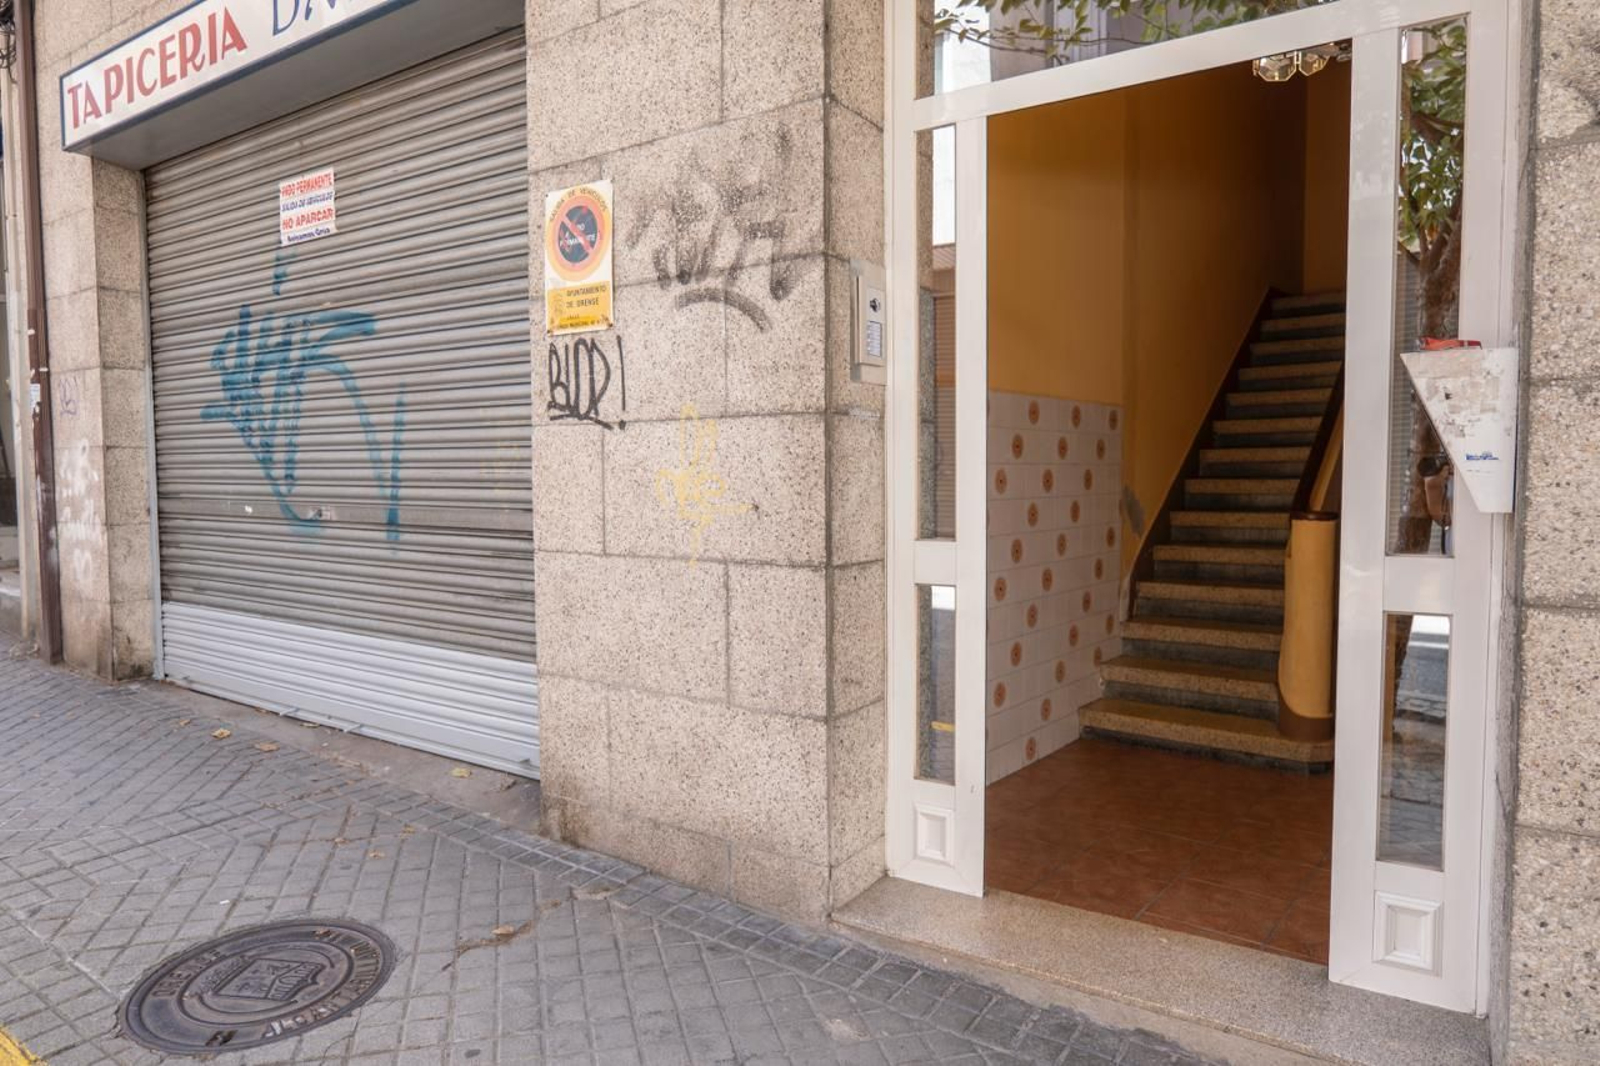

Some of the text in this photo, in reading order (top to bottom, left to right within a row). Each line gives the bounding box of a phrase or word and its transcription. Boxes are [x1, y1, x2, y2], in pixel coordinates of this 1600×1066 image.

[67, 7, 248, 129] TAPICERIA
[282, 208, 333, 230] NO APARCAR
[576, 297, 599, 308] ORENSE
